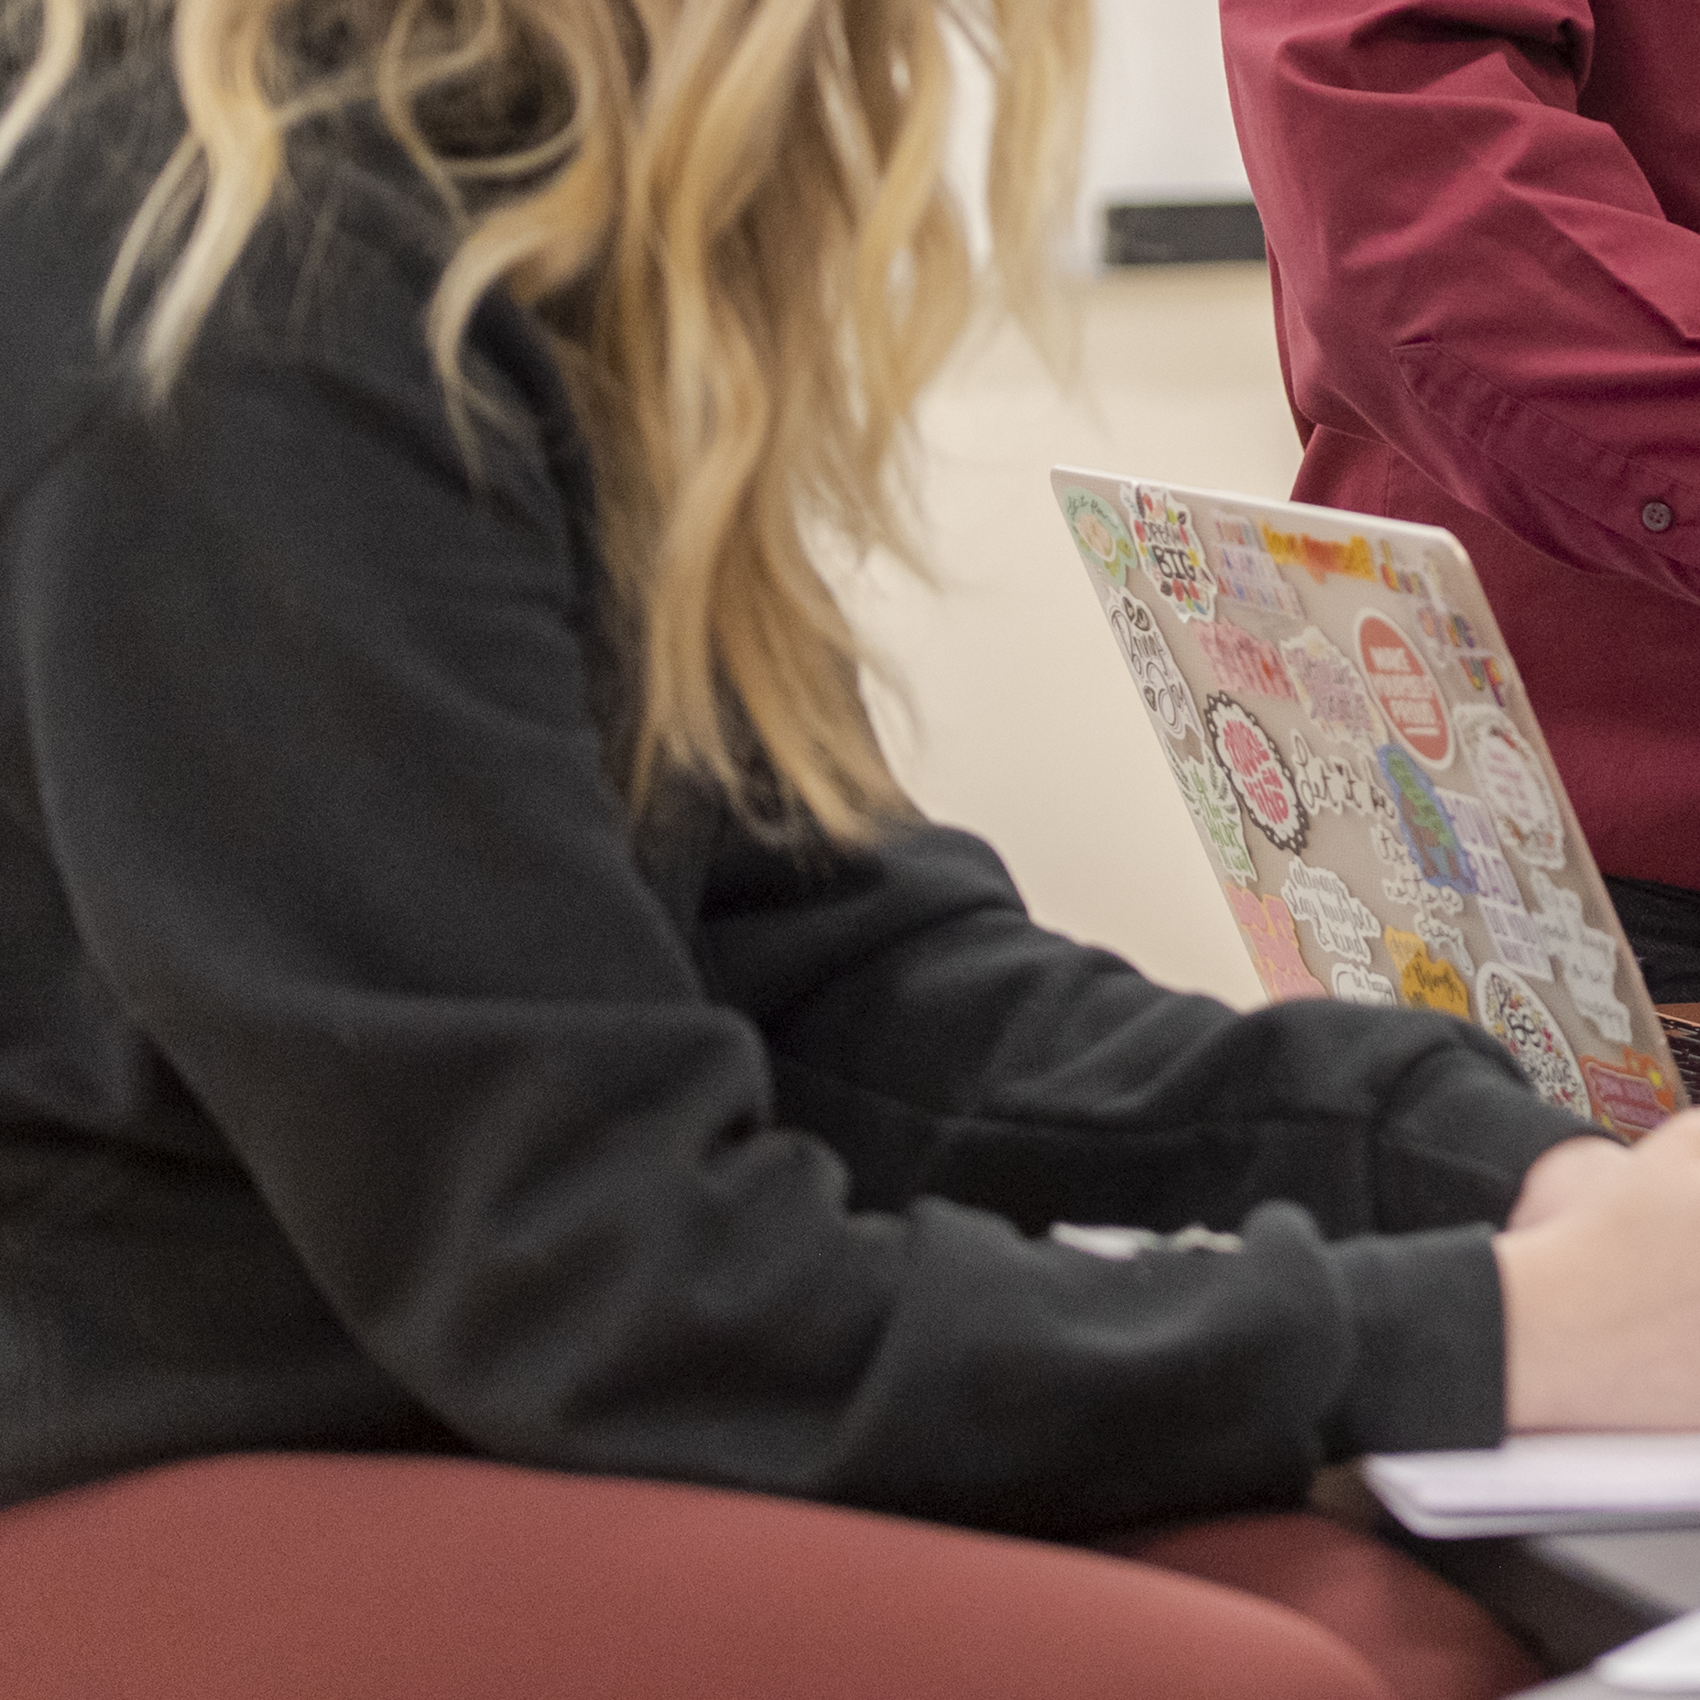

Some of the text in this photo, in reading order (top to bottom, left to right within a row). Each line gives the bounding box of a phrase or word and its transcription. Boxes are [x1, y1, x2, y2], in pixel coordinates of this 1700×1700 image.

[1142, 520, 1181, 544] DREAM
[1151, 545, 1197, 581] BIG
[1110, 604, 1169, 677] Bring
[1146, 660, 1201, 738] Joy
[1293, 734, 1339, 810] Let
[1334, 763, 1363, 809] it
[1317, 891, 1377, 933] humble
[1326, 921, 1366, 957] kind
